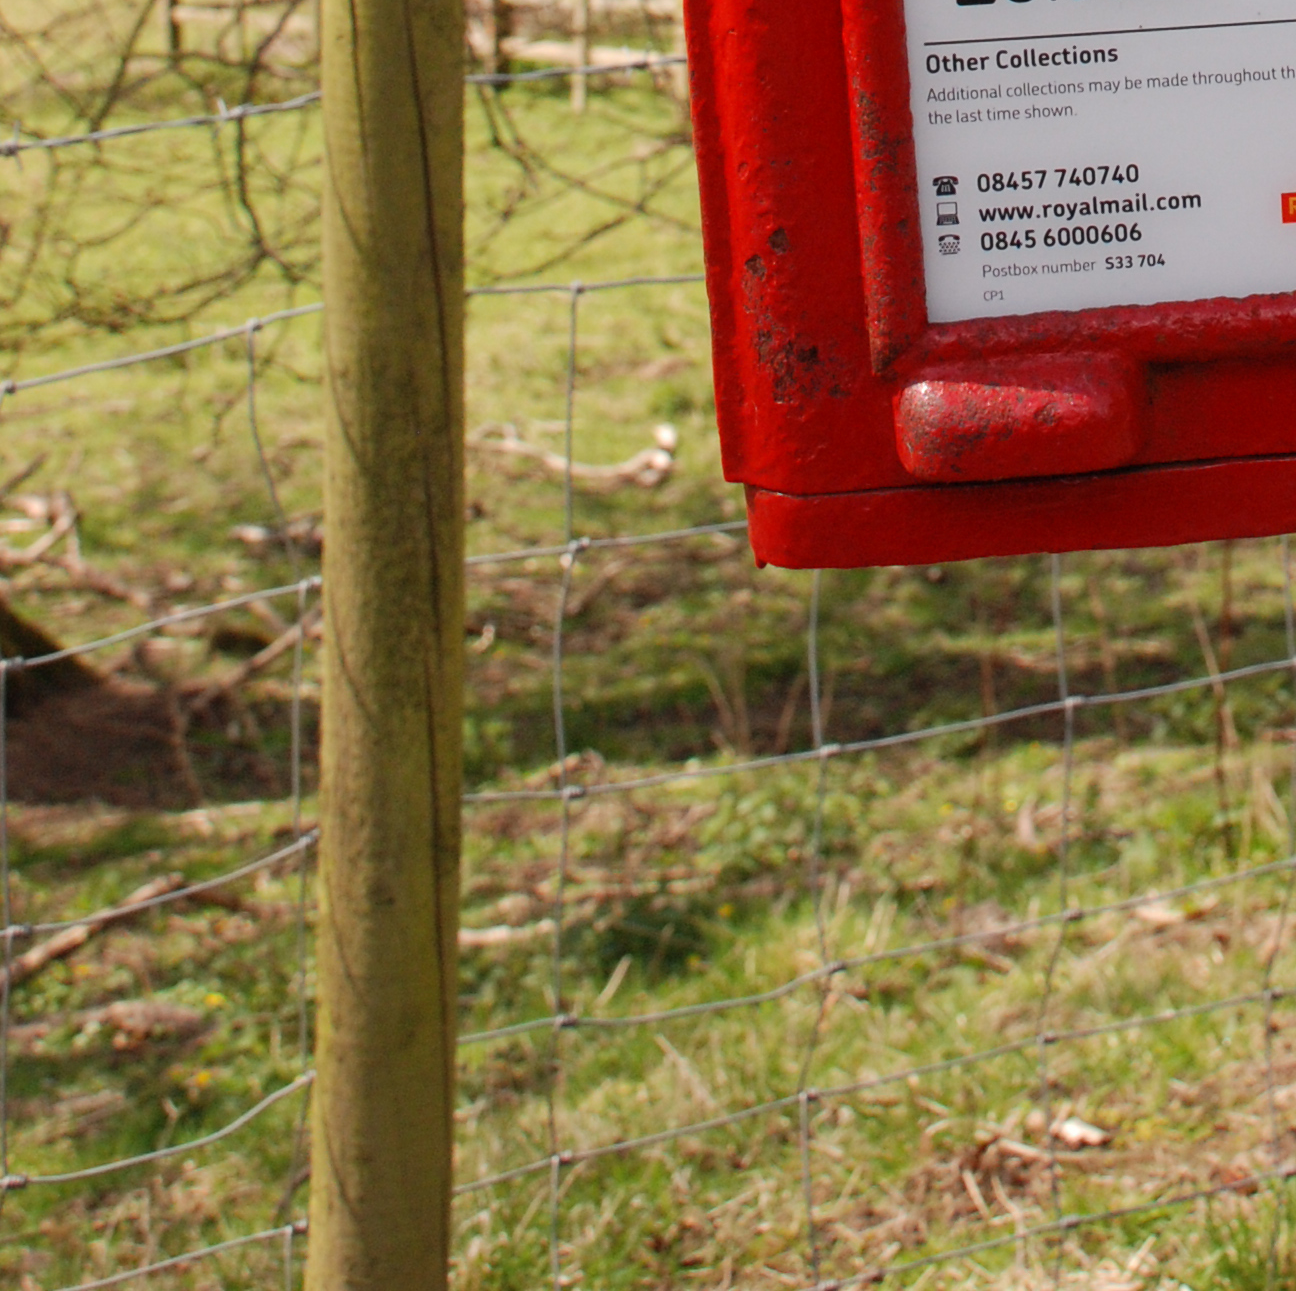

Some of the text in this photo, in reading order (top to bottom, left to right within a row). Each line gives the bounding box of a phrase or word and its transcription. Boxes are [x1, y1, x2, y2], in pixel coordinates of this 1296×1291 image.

[925, 45, 1119, 74] Other Collections
[926, 84, 1002, 103] Additional
[1005, 82, 1085, 98] collections
[1088, 80, 1121, 94] may
[1124, 76, 1143, 90] be
[1146, 72, 1189, 89] made
[1192, 67, 1277, 86] throughout
[927, 103, 1078, 125] the last time shown.
[977, 163, 1139, 193] 08457 740740
[978, 192, 1202, 223] www.royalmail.com
[980, 222, 1142, 252] 0845 6000606
[982, 253, 1166, 278] Postbox number S33 704
[983, 289, 1005, 302] CP1
